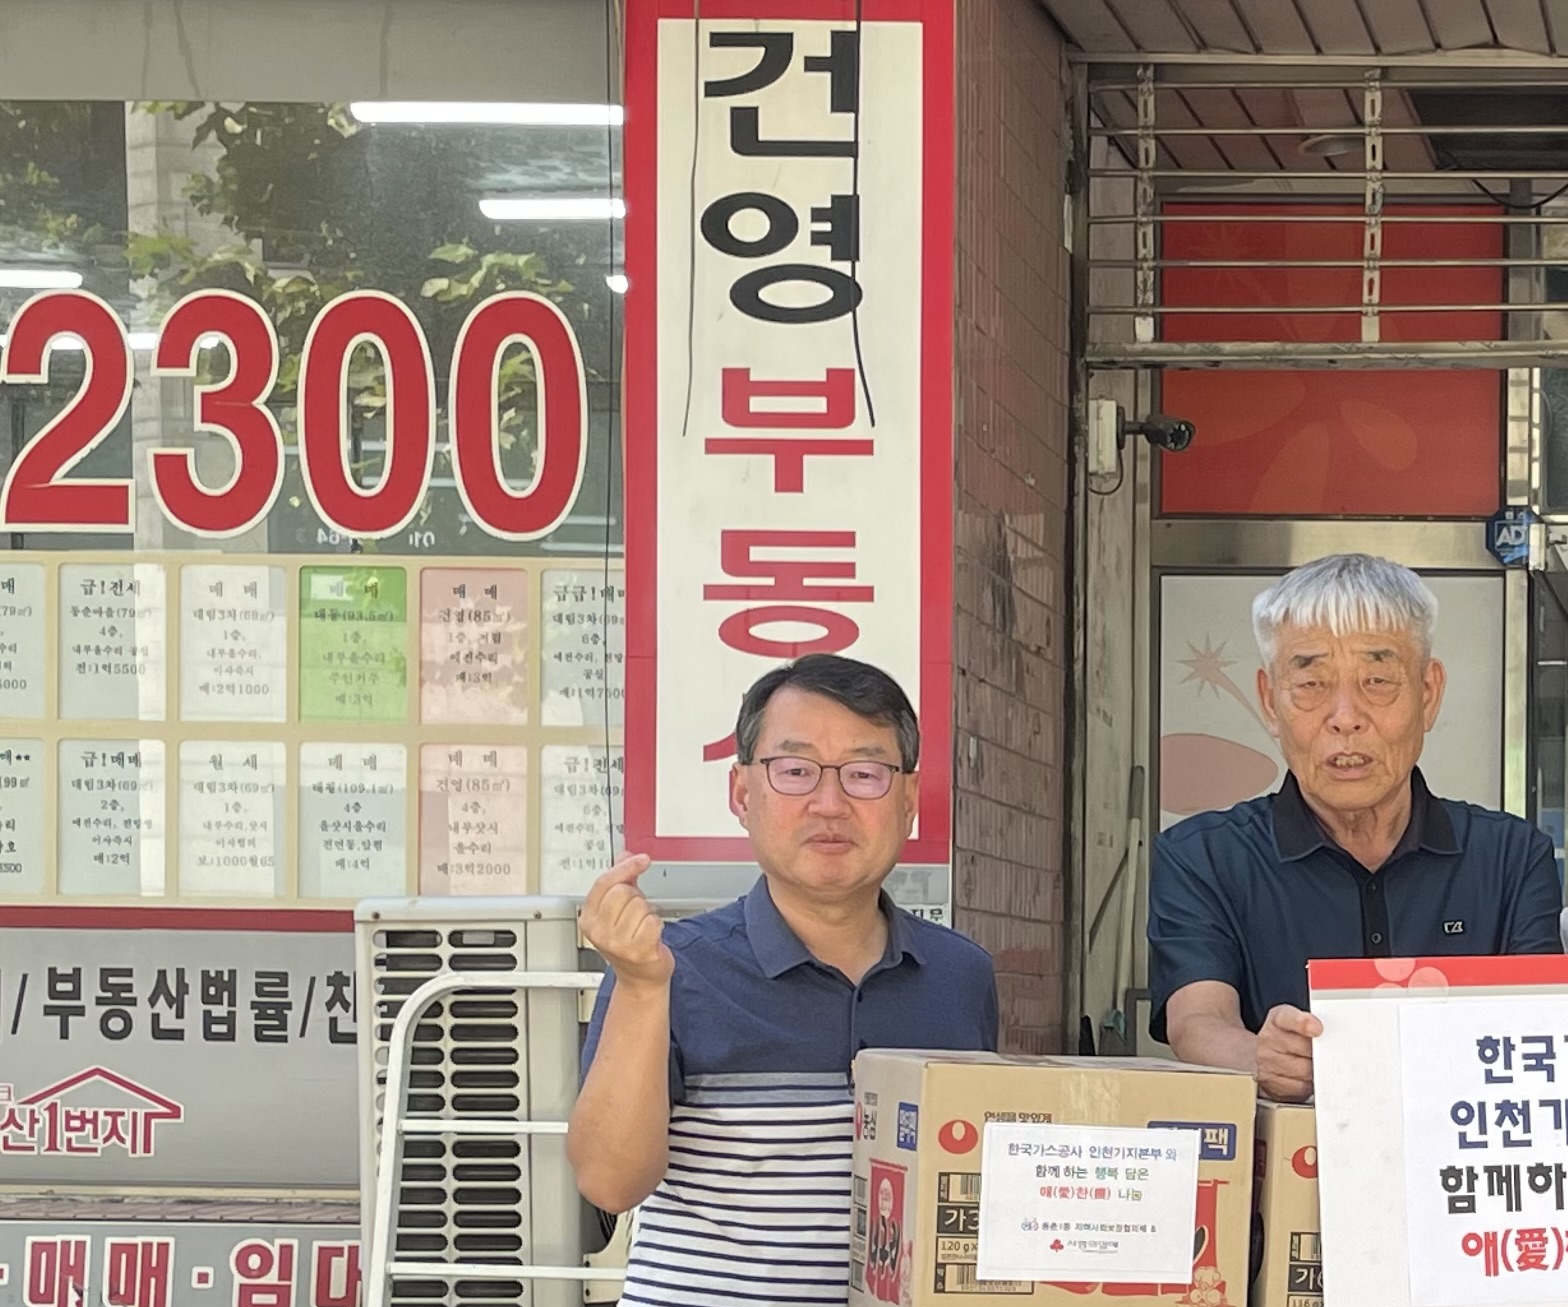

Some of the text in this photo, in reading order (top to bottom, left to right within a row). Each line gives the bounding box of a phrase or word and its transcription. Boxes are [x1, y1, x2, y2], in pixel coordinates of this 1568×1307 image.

[2, 288, 588, 542] 2300
[1008, 1143, 1083, 1158] 한국가스공사
[1089, 1146, 1162, 1160] 인천기지본부
[1036, 1165, 1060, 1178] 함께
[1063, 1166, 1088, 1179] 하는
